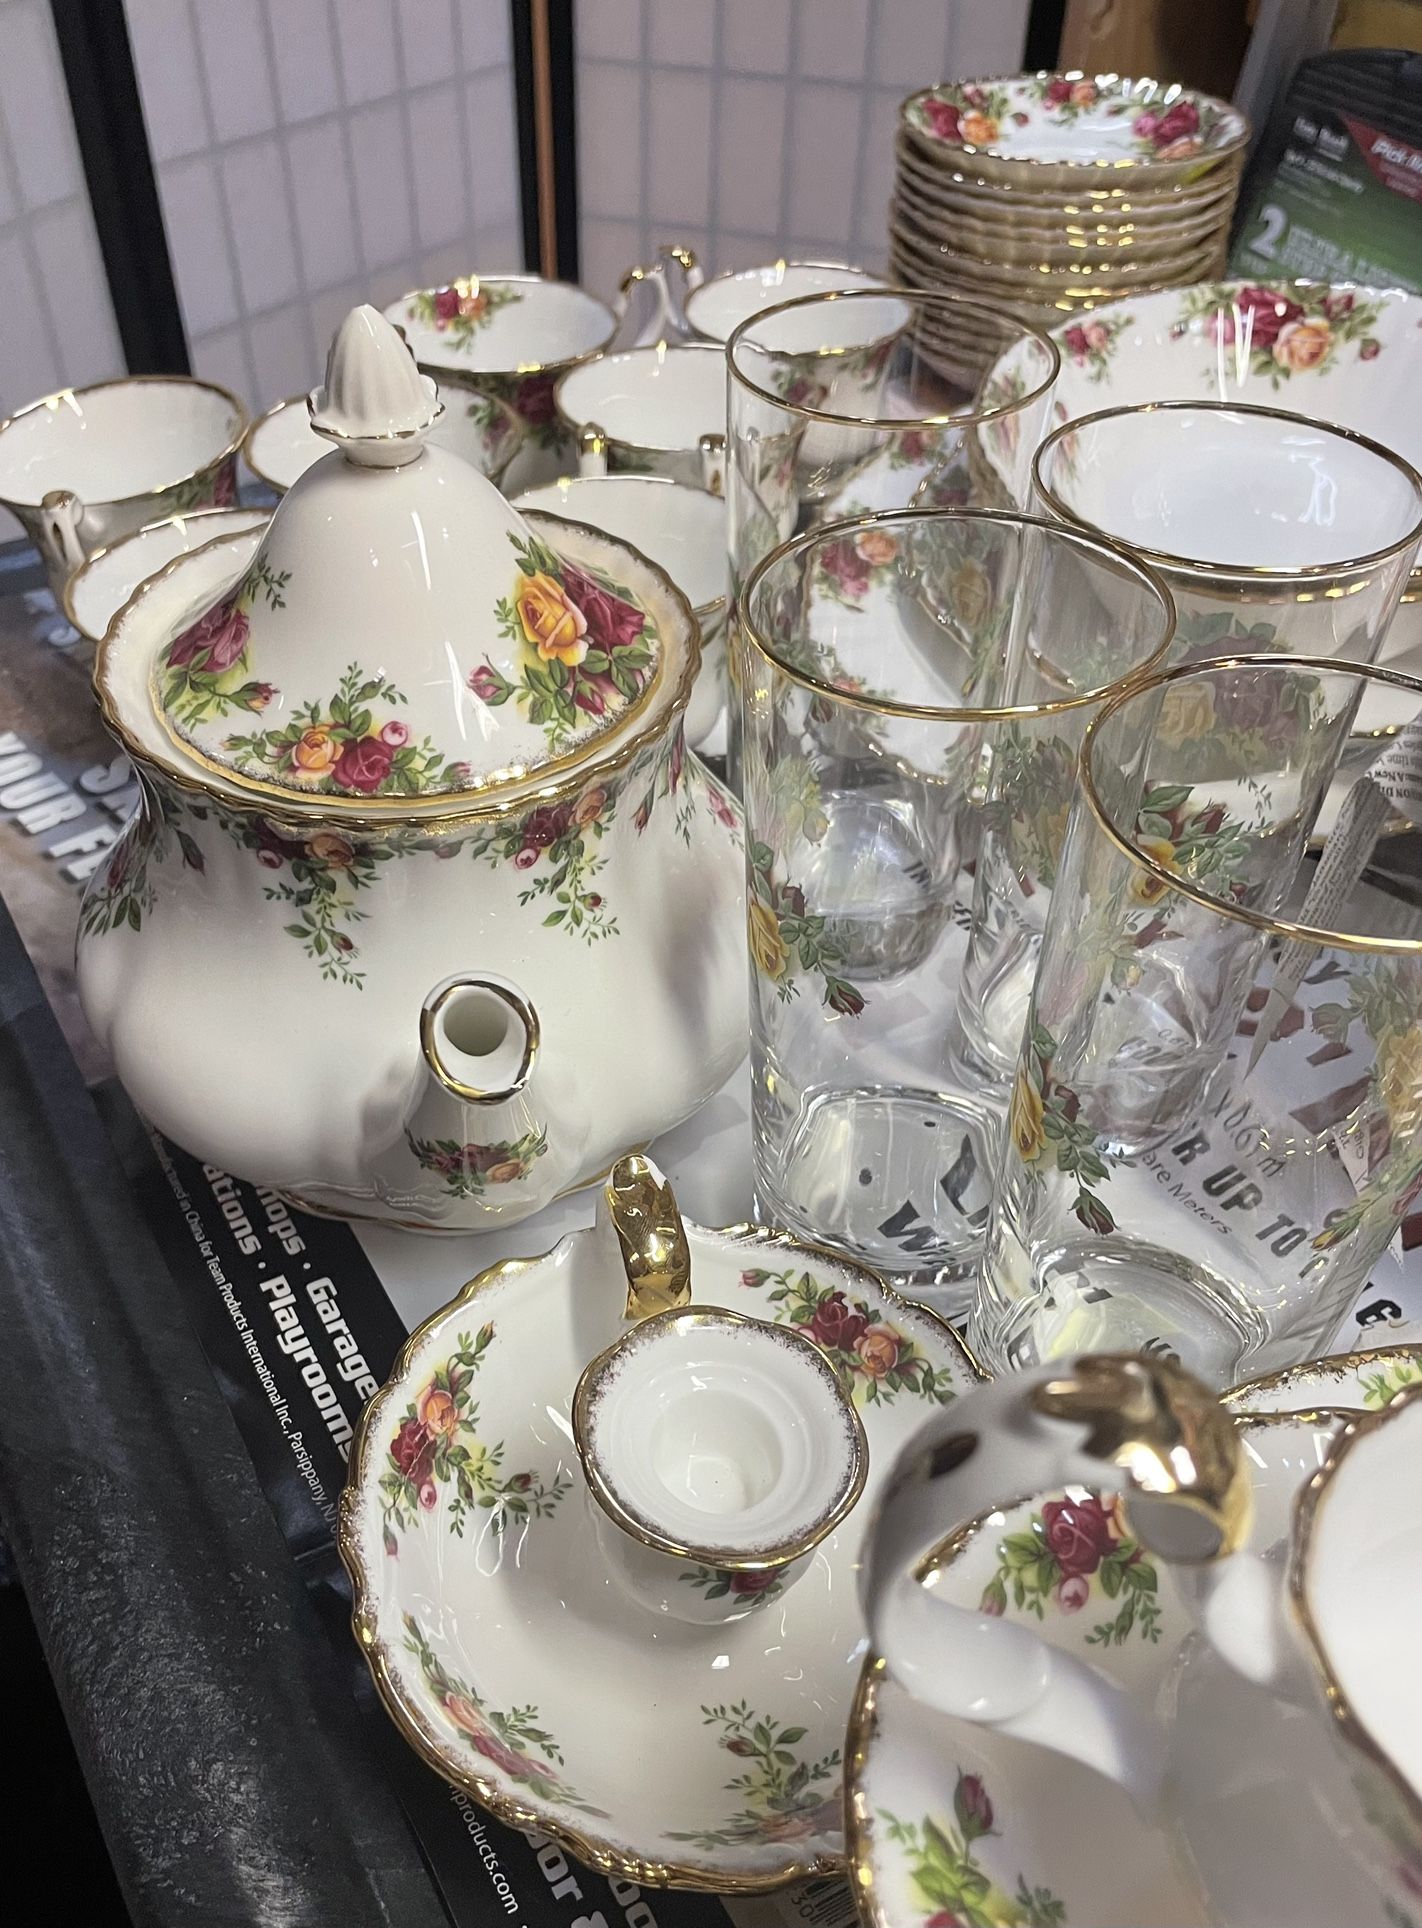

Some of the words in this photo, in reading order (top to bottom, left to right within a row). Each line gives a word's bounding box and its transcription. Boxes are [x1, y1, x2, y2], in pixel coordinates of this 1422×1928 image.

[1250, 203, 1287, 258] 2
[185, 1210, 205, 1242] China
[203, 1164, 262, 1255] ations
[1167, 1181, 1233, 1235] Meters
[1202, 1164, 1264, 1211] UP
[1255, 1213, 1308, 1257] TO
[199, 1240, 214, 1257] for
[206, 1255, 226, 1286] Team
[218, 1283, 249, 1331] Products
[240, 1328, 288, 1407] International
[306, 1276, 379, 1405] Garage
